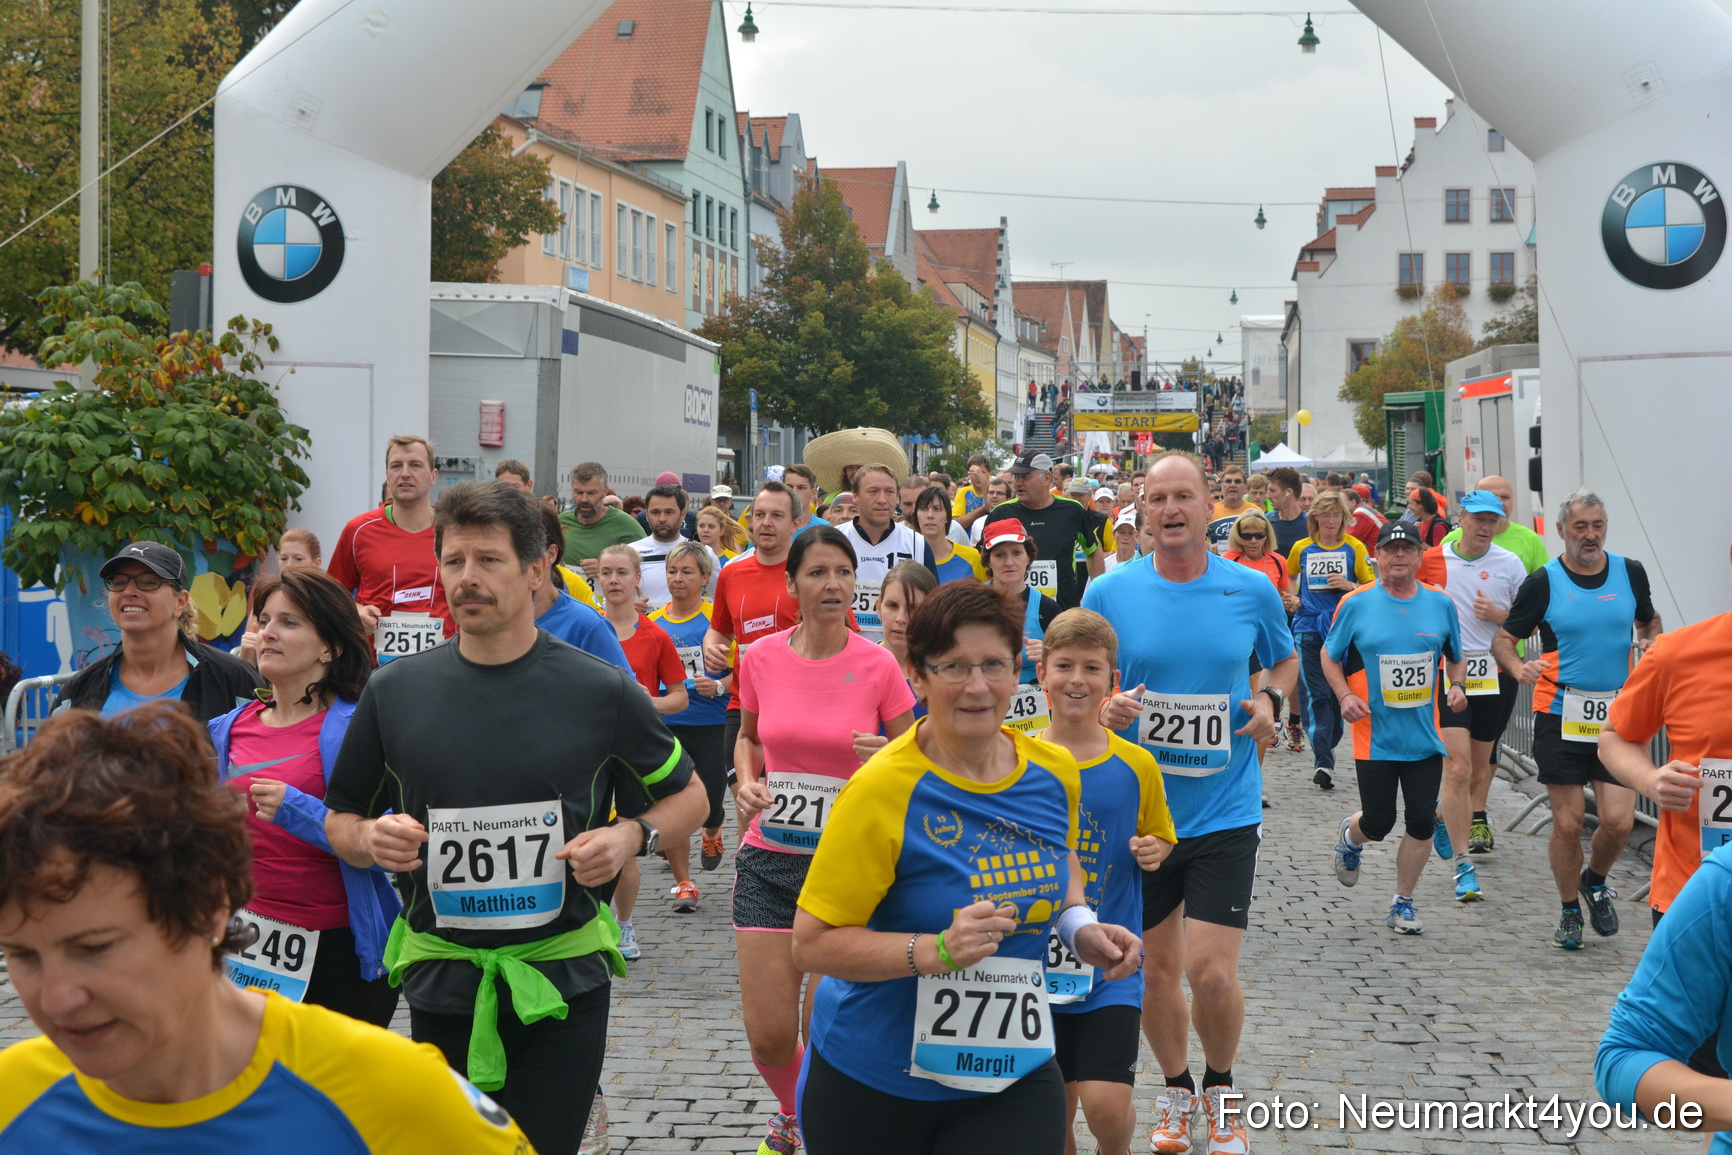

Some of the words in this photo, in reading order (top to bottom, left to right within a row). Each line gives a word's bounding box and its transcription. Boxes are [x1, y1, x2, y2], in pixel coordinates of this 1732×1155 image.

[1611, 164, 1719, 208] BMW
[244, 187, 337, 227] BMW
[684, 384, 713, 428] BOCK
[1114, 417, 1157, 427] START
[1310, 561, 1343, 575] 2265
[404, 591, 422, 599] DEHN
[851, 592, 880, 612] 257
[751, 620, 767, 628] DEHN
[383, 631, 436, 653] 2515
[1401, 658, 1427, 666] Neumarkt
[1467, 659, 1488, 677] 28
[1392, 666, 1426, 688] 325
[1465, 681, 1483, 689] oland
[1397, 690, 1422, 701] Günter
[1005, 695, 1037, 719] 43
[1142, 698, 1172, 710] PARTL
[1174, 702, 1216, 711] Neumarkt
[1583, 700, 1608, 721] 98
[1147, 712, 1222, 746] 2210
[1578, 725, 1600, 735] Wern
[1159, 750, 1208, 766] Manfred
[1702, 768, 1732, 780] PART
[768, 780, 796, 790] PARTL
[797, 781, 841, 795] Neumarkt
[768, 793, 834, 829] 221
[936, 815, 947, 823] 15
[431, 821, 470, 834] PARTL
[473, 816, 538, 832] Neumarkt
[934, 825, 957, 835] Jahre
[782, 831, 821, 847] Martin
[439, 833, 551, 885] 2617
[1079, 856, 1097, 865] 2014
[432, 882, 439, 890] D
[986, 886, 1037, 903] September
[1038, 882, 1060, 895] 2014
[460, 893, 537, 913] Matthias
[1047, 934, 1083, 971] 34
[225, 966, 281, 993] Manuela
[922, 970, 971, 982] ARTL
[974, 970, 1028, 984] Neumarkt
[931, 988, 1042, 1041] 2776
[920, 1033, 927, 1042] D
[956, 1052, 1016, 1077] Margit
